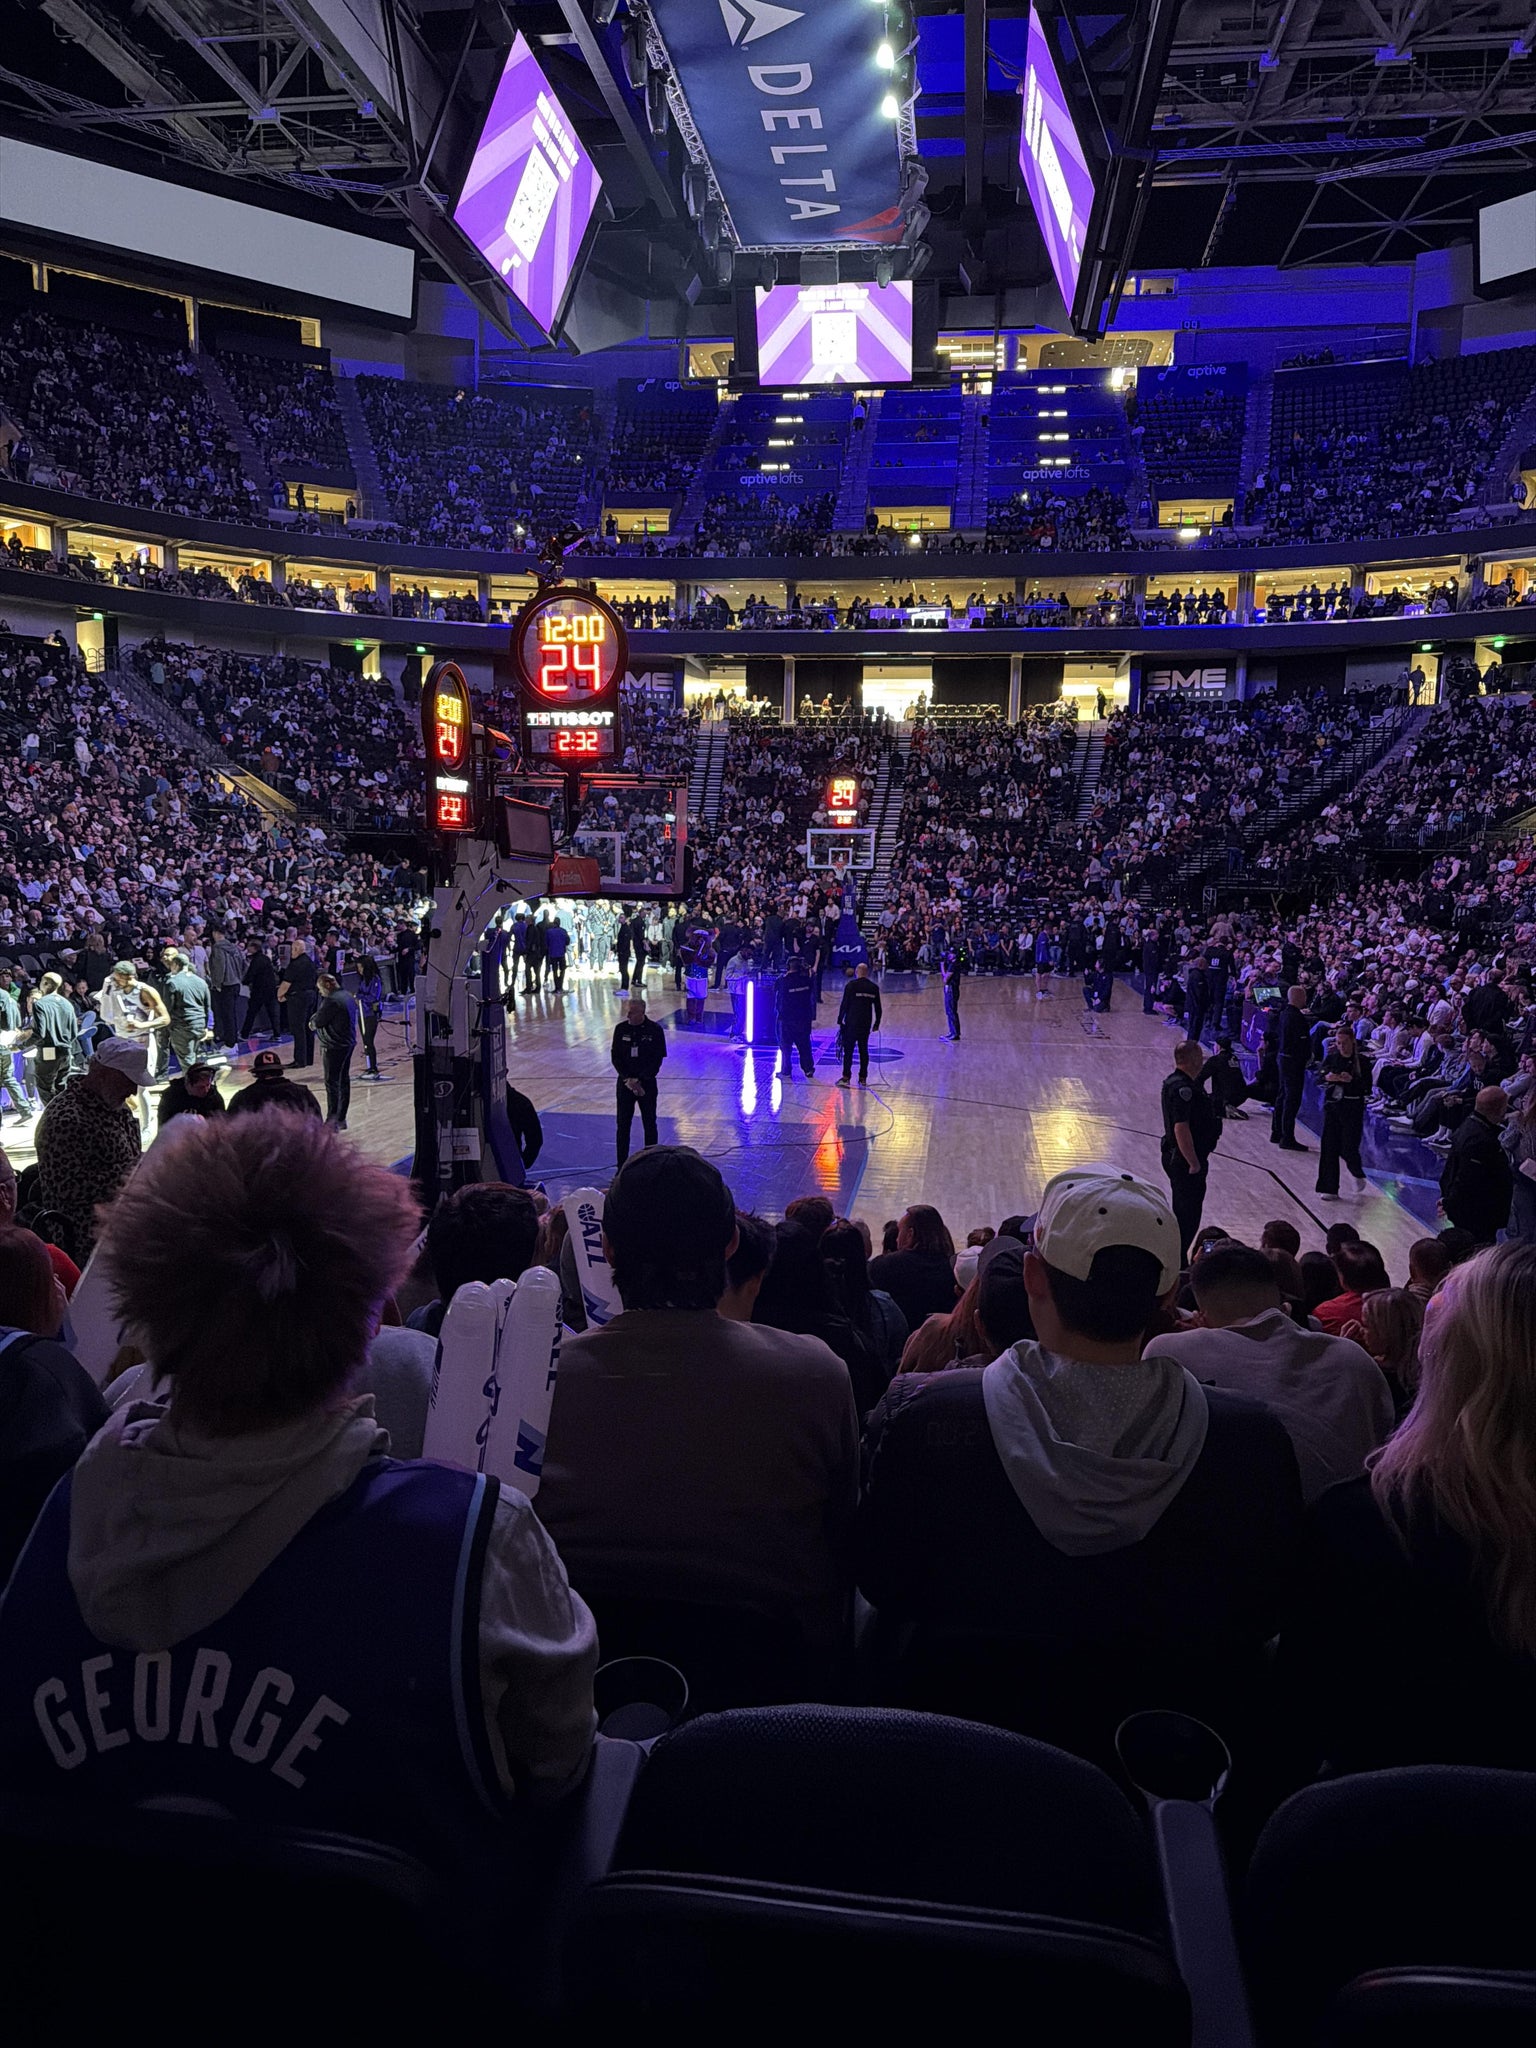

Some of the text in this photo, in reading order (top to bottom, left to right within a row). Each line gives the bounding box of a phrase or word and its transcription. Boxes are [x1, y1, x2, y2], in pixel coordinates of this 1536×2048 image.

[748, 62, 841, 220] DELTA
[1188, 364, 1227, 379] aptive
[740, 471, 804, 487] aptive lofts
[1023, 466, 1090, 482] aptive lofts
[544, 615, 605, 643] 12:00
[540, 644, 601, 692] 24
[620, 671, 674, 691] ME
[1147, 667, 1227, 690] SME
[551, 712, 614, 726] TISSOT
[437, 722, 458, 757] 24
[558, 731, 598, 751] 2:32
[832, 790, 854, 806] 24
[832, 945, 862, 953] KIA
[33, 1648, 351, 1789] GEORGE
